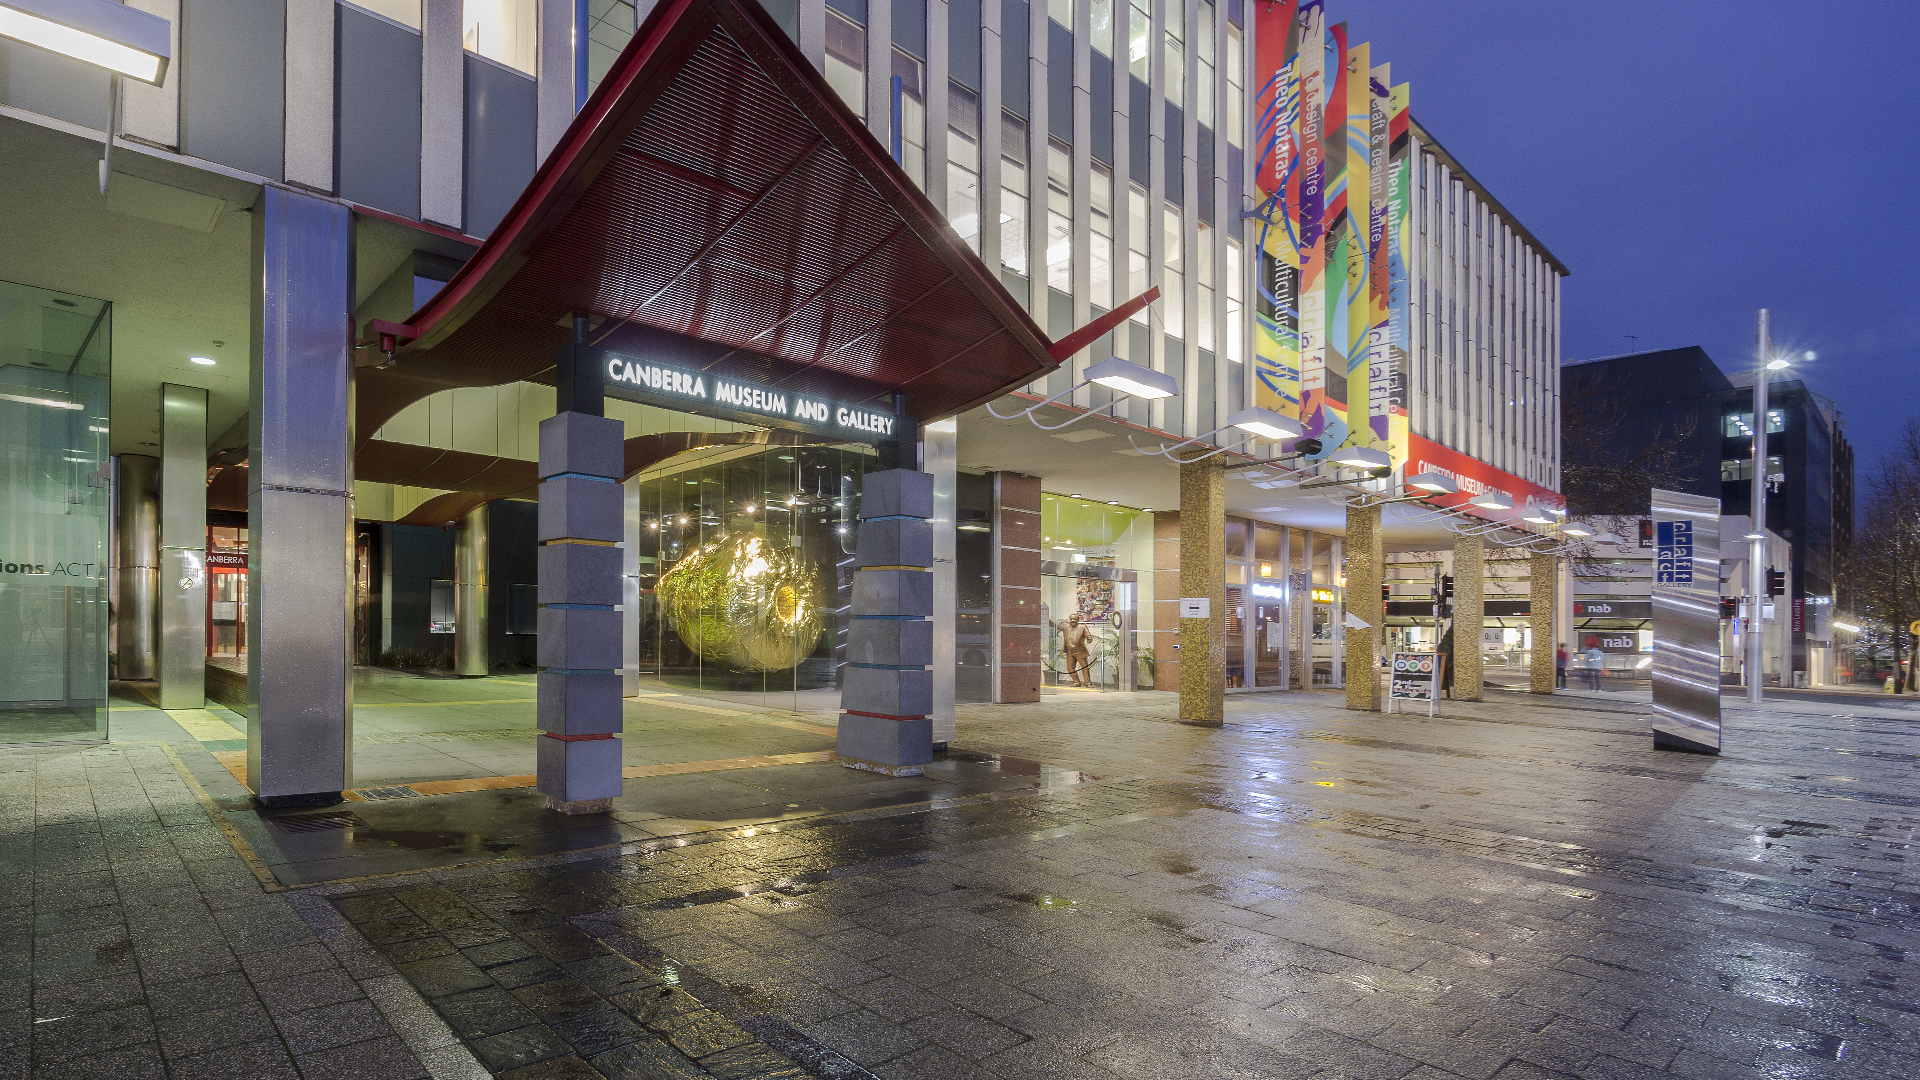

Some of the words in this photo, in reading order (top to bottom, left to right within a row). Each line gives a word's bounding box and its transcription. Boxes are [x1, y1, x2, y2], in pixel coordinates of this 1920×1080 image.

[1306, 37, 1320, 72] craft
[1275, 62, 1292, 108] Theo
[1306, 74, 1320, 89] &
[1303, 91, 1320, 144] design
[1371, 100, 1384, 132] craft
[1275, 110, 1292, 180] Notaras
[1371, 134, 1385, 145] &
[1306, 148, 1320, 196] centre
[1369, 148, 1385, 195] design
[1388, 158, 1402, 197] Theo
[1371, 199, 1384, 242] centre
[1388, 198, 1402, 257] Notaras
[1274, 240, 1294, 341] Multicultural
[1369, 331, 1388, 410] craft
[1389, 308, 1403, 392] Multicultural
[608, 358, 706, 398] CANBERRA
[715, 382, 787, 414] MUSEUM
[794, 399, 828, 422] AND
[836, 407, 894, 435] GALLERY
[52, 562, 94, 577] ACT
[205, 555, 244, 564] ANBERRA
[1674, 522, 1692, 580] craft
[1587, 604, 1611, 613] nab
[1602, 635, 1633, 648] nab
